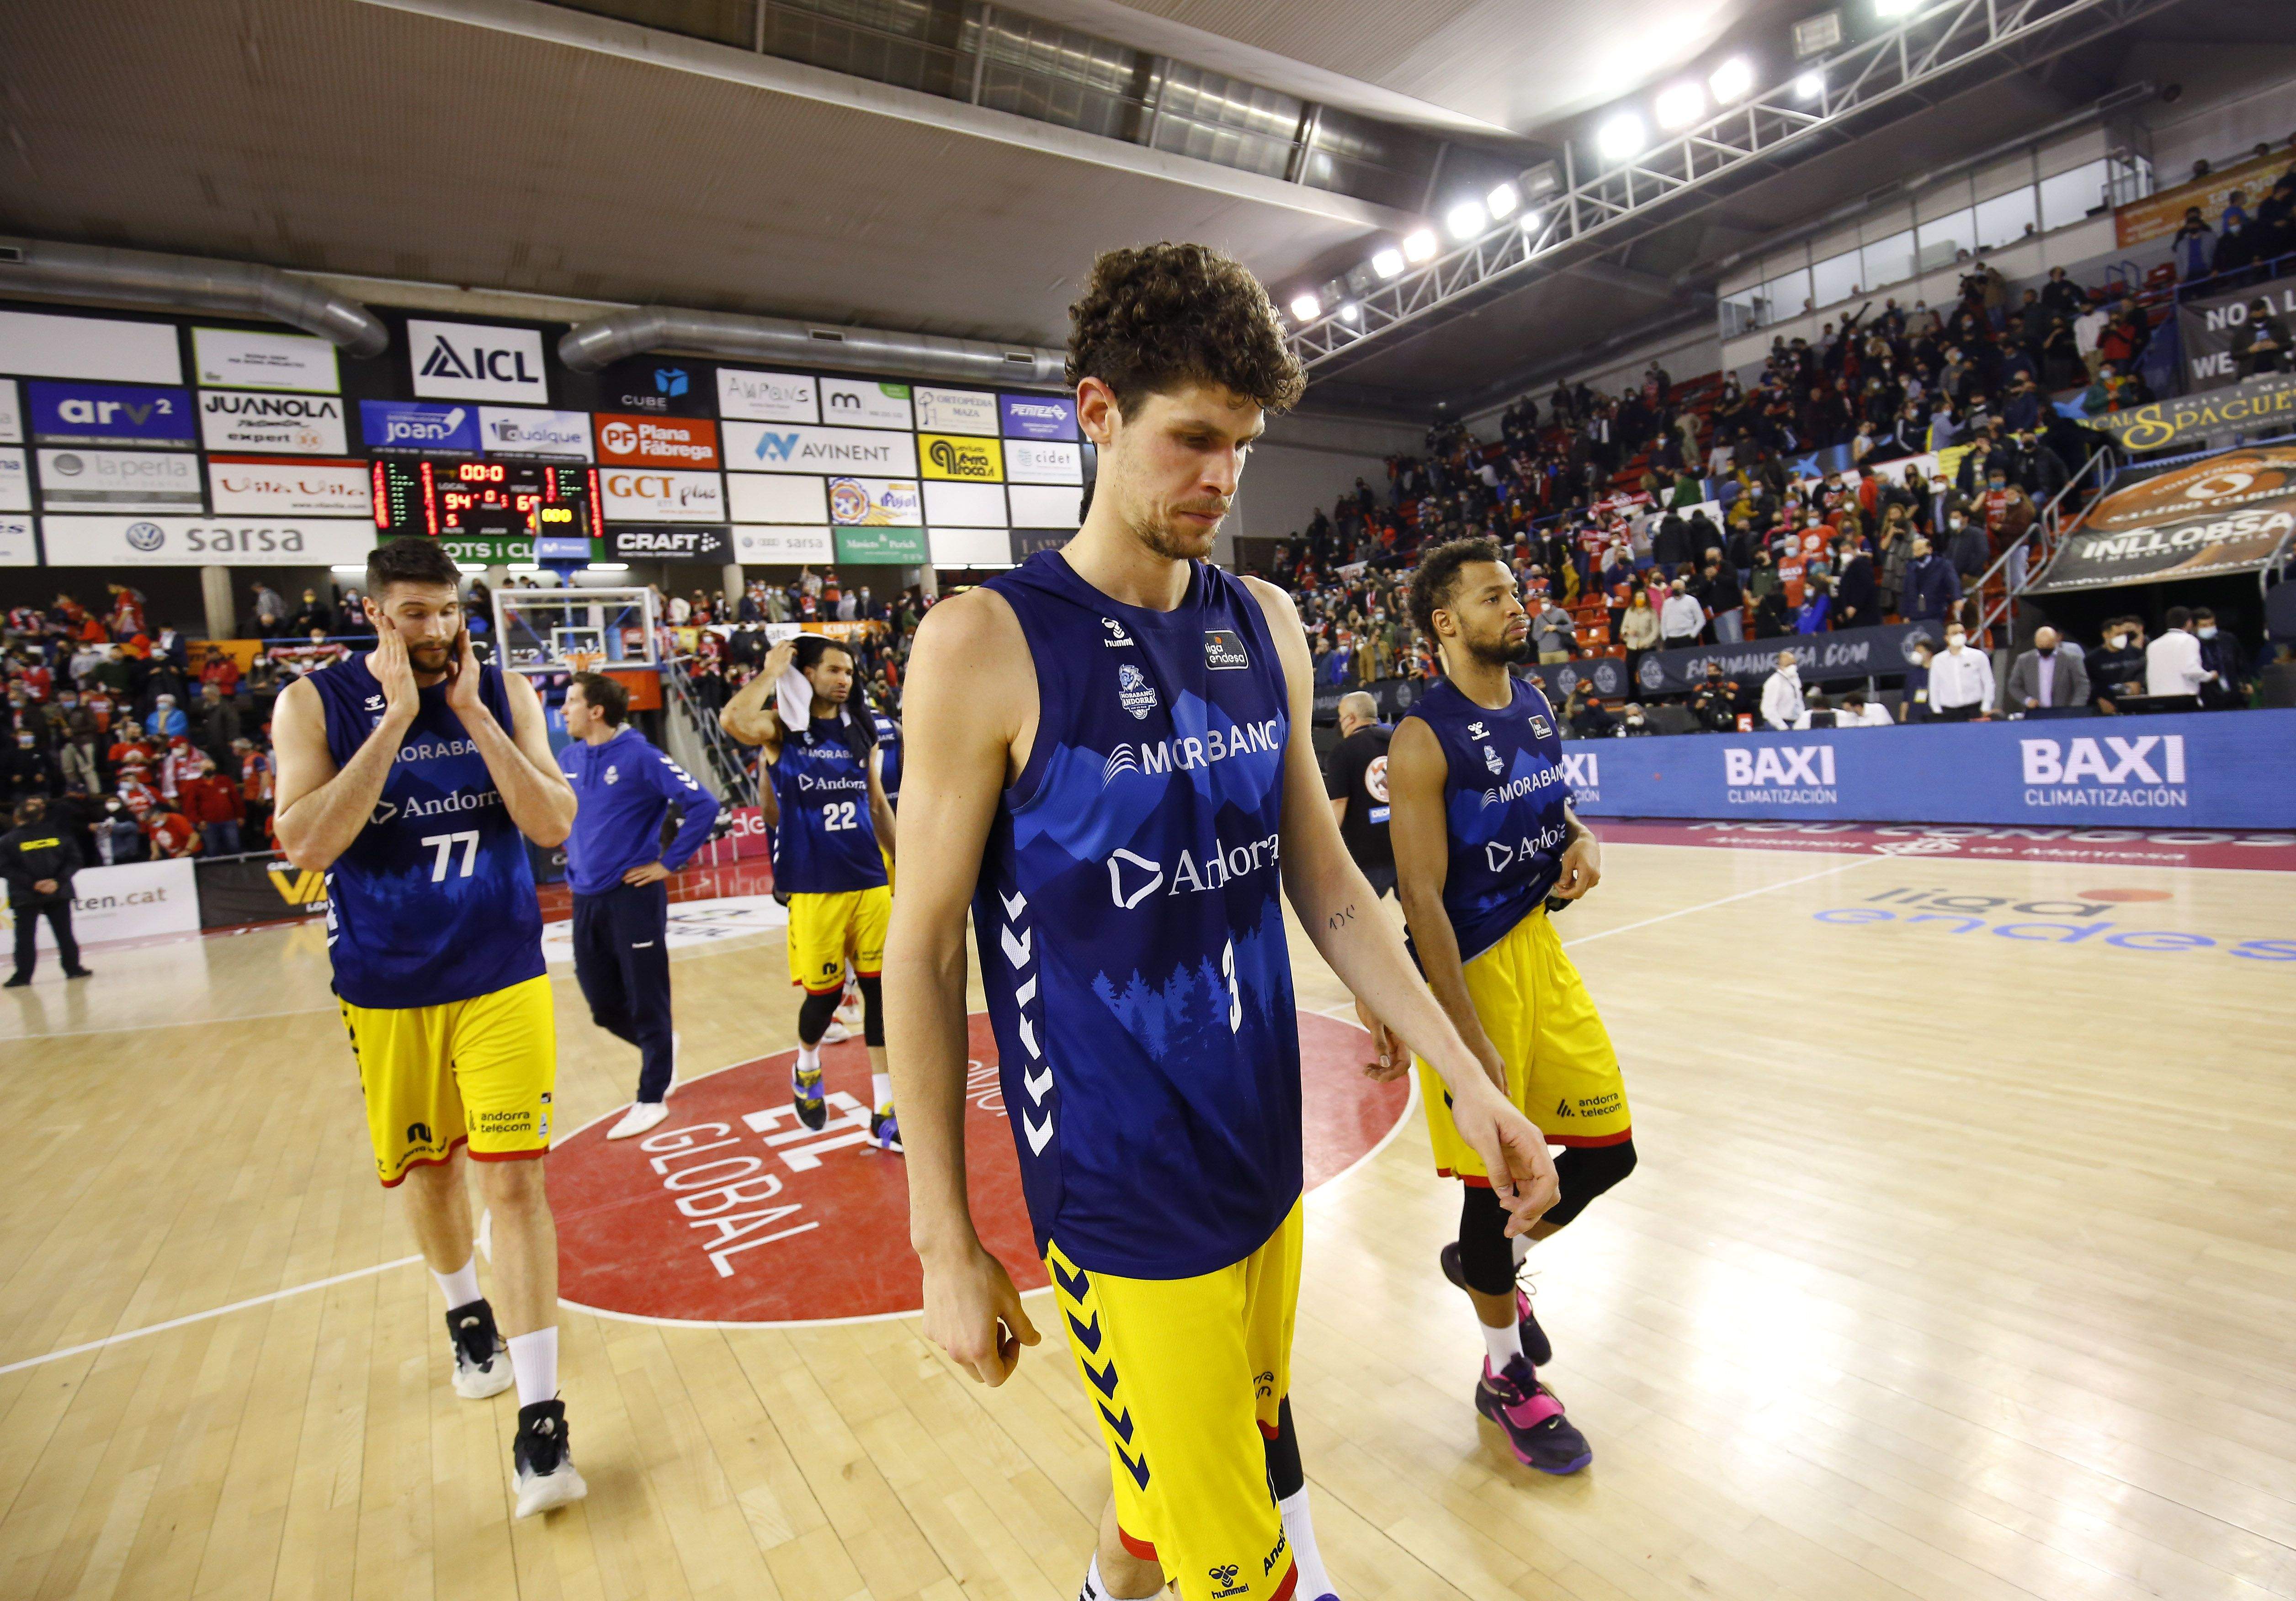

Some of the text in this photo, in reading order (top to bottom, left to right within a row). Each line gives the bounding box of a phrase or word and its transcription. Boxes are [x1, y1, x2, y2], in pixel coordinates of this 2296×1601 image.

[2206, 302, 2248, 332] NO
[206, 395, 338, 419] JUANOLA
[621, 394, 668, 408] CUBE
[2123, 387, 2296, 450] SPAGUE
[228, 433, 291, 443] expert
[638, 424, 691, 442] Plana
[801, 442, 891, 461] AVINENT
[607, 475, 675, 498] GCT
[445, 493, 473, 510] 94
[186, 528, 303, 552] sarsa
[617, 532, 700, 551] CRAFT
[786, 536, 824, 548] sarsa
[2081, 512, 2295, 559] INLLOBSA
[438, 542, 492, 558] OTS
[507, 542, 534, 558] CL
[1205, 642, 1223, 654] liga
[1209, 652, 1245, 663] endesa
[1121, 690, 1153, 699] MORABANC
[1122, 695, 1155, 707] ANDORRA
[1739, 716, 1752, 731] 5
[395, 739, 479, 763] ORABA
[808, 748, 854, 759] MORAB
[2020, 734, 2186, 785] BAXI
[1562, 753, 1599, 786] XI
[1724, 745, 1836, 786] BAXI
[1499, 762, 1565, 804] MORABAN
[1728, 787, 1837, 805] CLIMATIZACIÓN
[2024, 785, 2187, 807] CLIMATIZACIÓN
[823, 801, 858, 832] 22
[420, 829, 479, 883] 77
[72, 886, 166, 911] ten.cat
[1864, 887, 2116, 917] liga
[1222, 938, 1242, 1035] 3
[1578, 1091, 1619, 1107] andorra
[481, 1111, 530, 1121] andorra
[1580, 1102, 1622, 1117] telecom
[481, 1122, 531, 1133] telecom
[640, 1122, 820, 1278] GLOBAL
[1211, 1582, 1250, 1600] hummel
